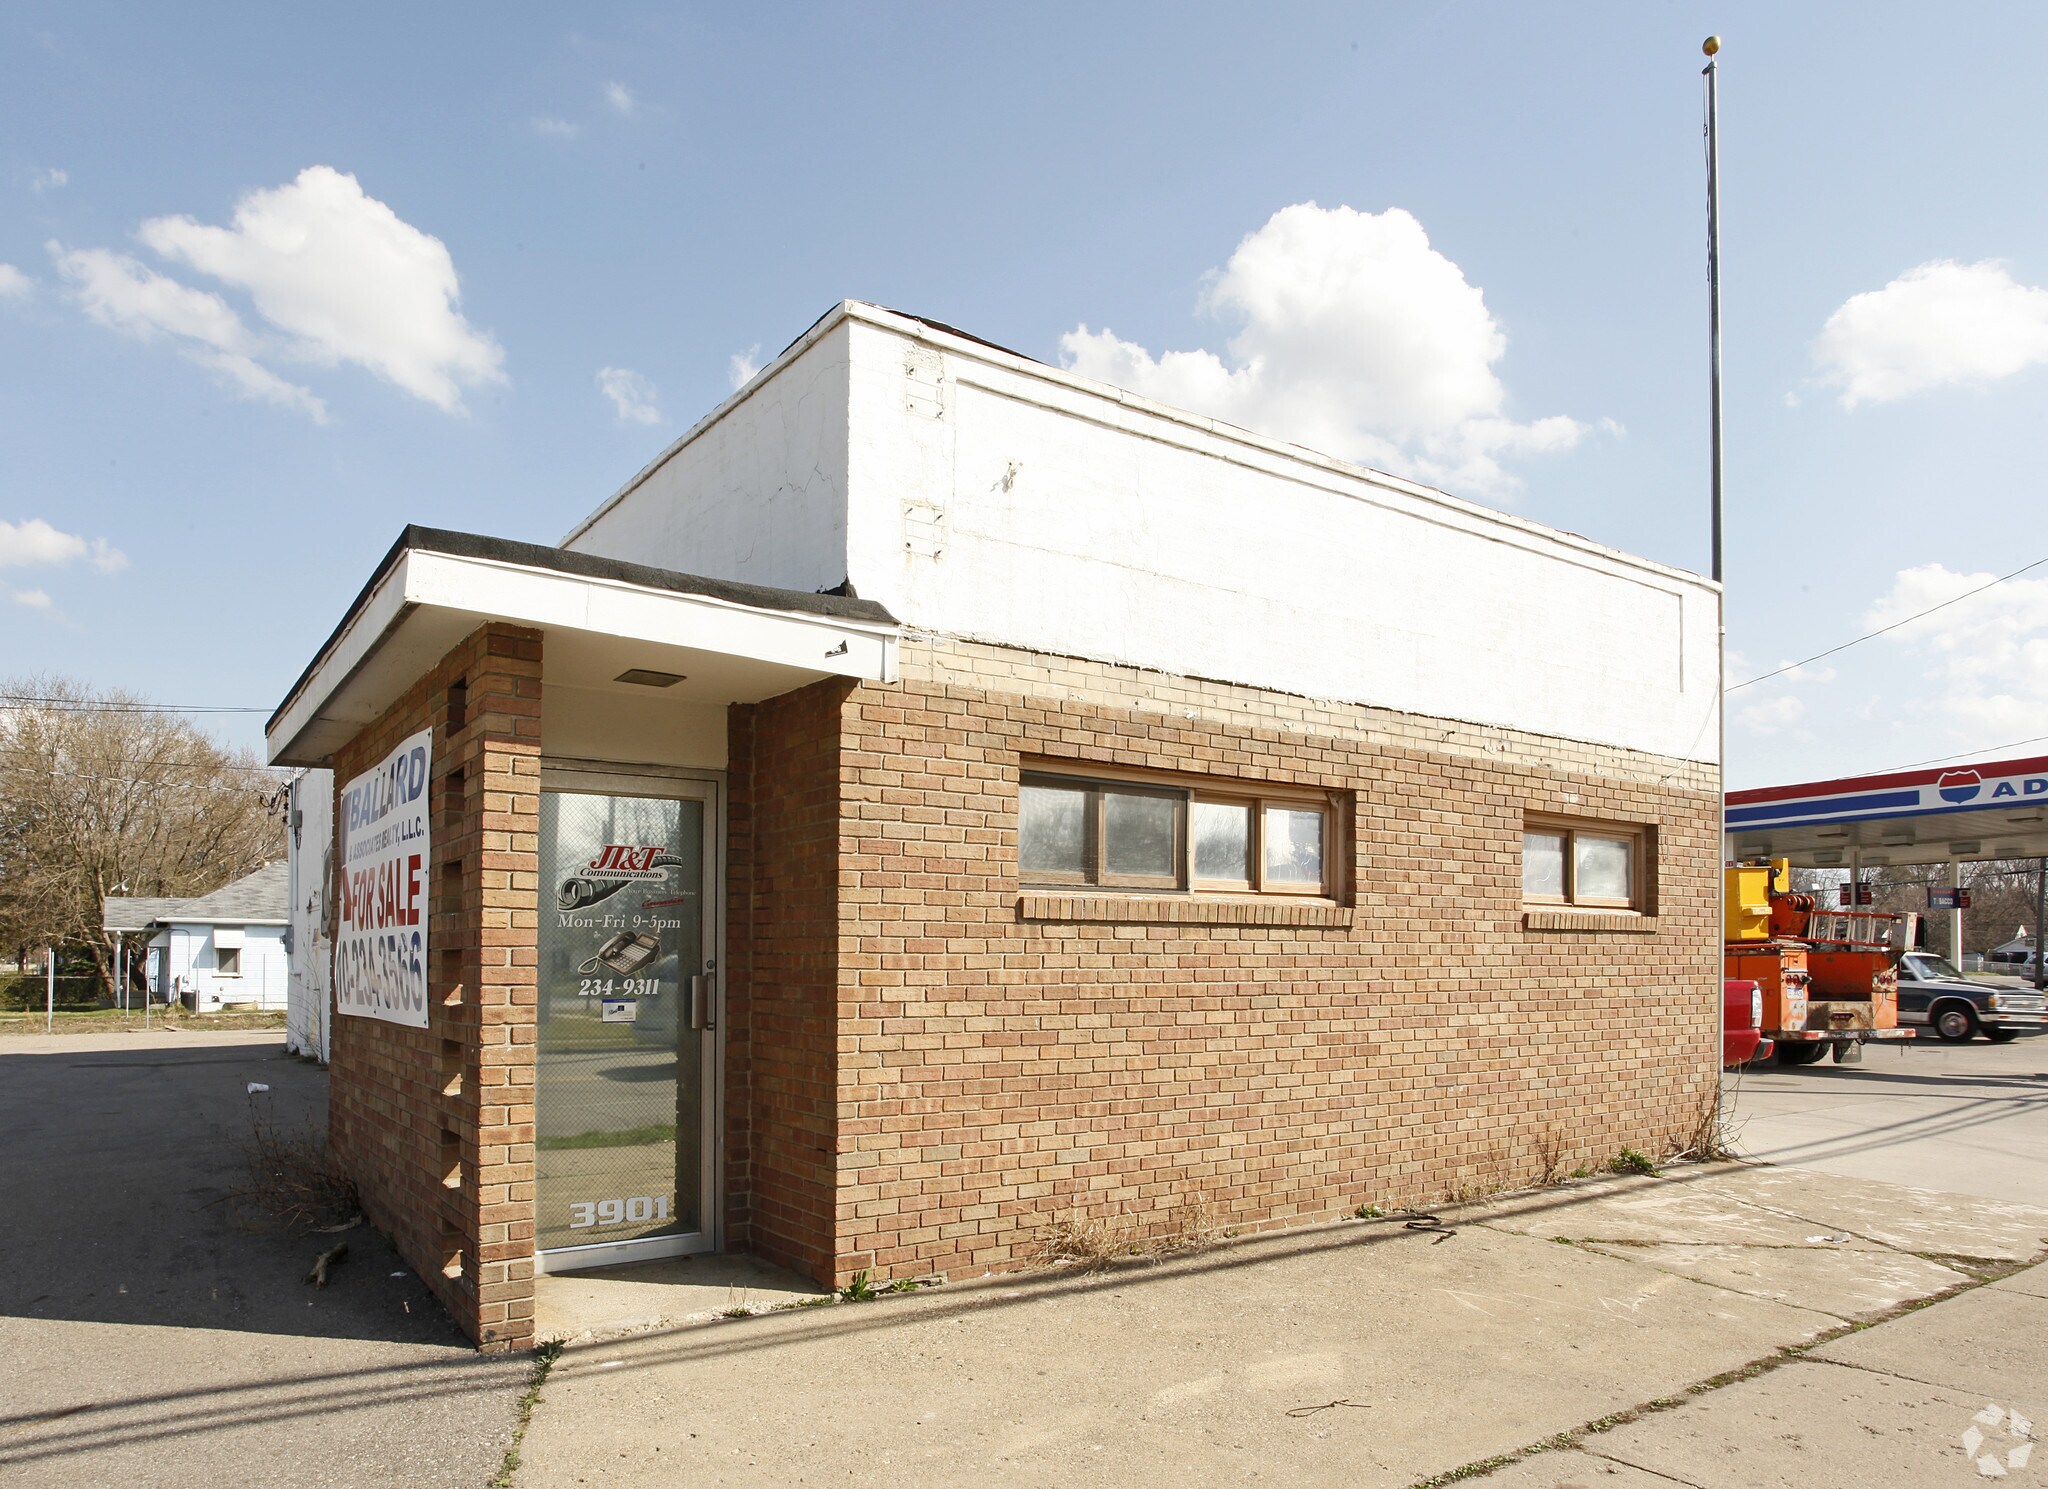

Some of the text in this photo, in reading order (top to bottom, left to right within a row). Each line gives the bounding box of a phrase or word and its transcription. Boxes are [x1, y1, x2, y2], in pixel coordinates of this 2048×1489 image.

[349, 746, 426, 832] BALLARD
[1992, 778, 2048, 798] AD
[353, 832, 382, 861] ASSOCIATES
[401, 816, 424, 841] L.L.C.
[589, 845, 666, 871] JT&T
[579, 867, 663, 879] Communications
[351, 853, 421, 932] FOR SALE
[557, 913, 681, 933] Mon-Fri 9-5pm
[578, 978, 660, 996] 234-9311
[569, 1193, 668, 1229] 3901
